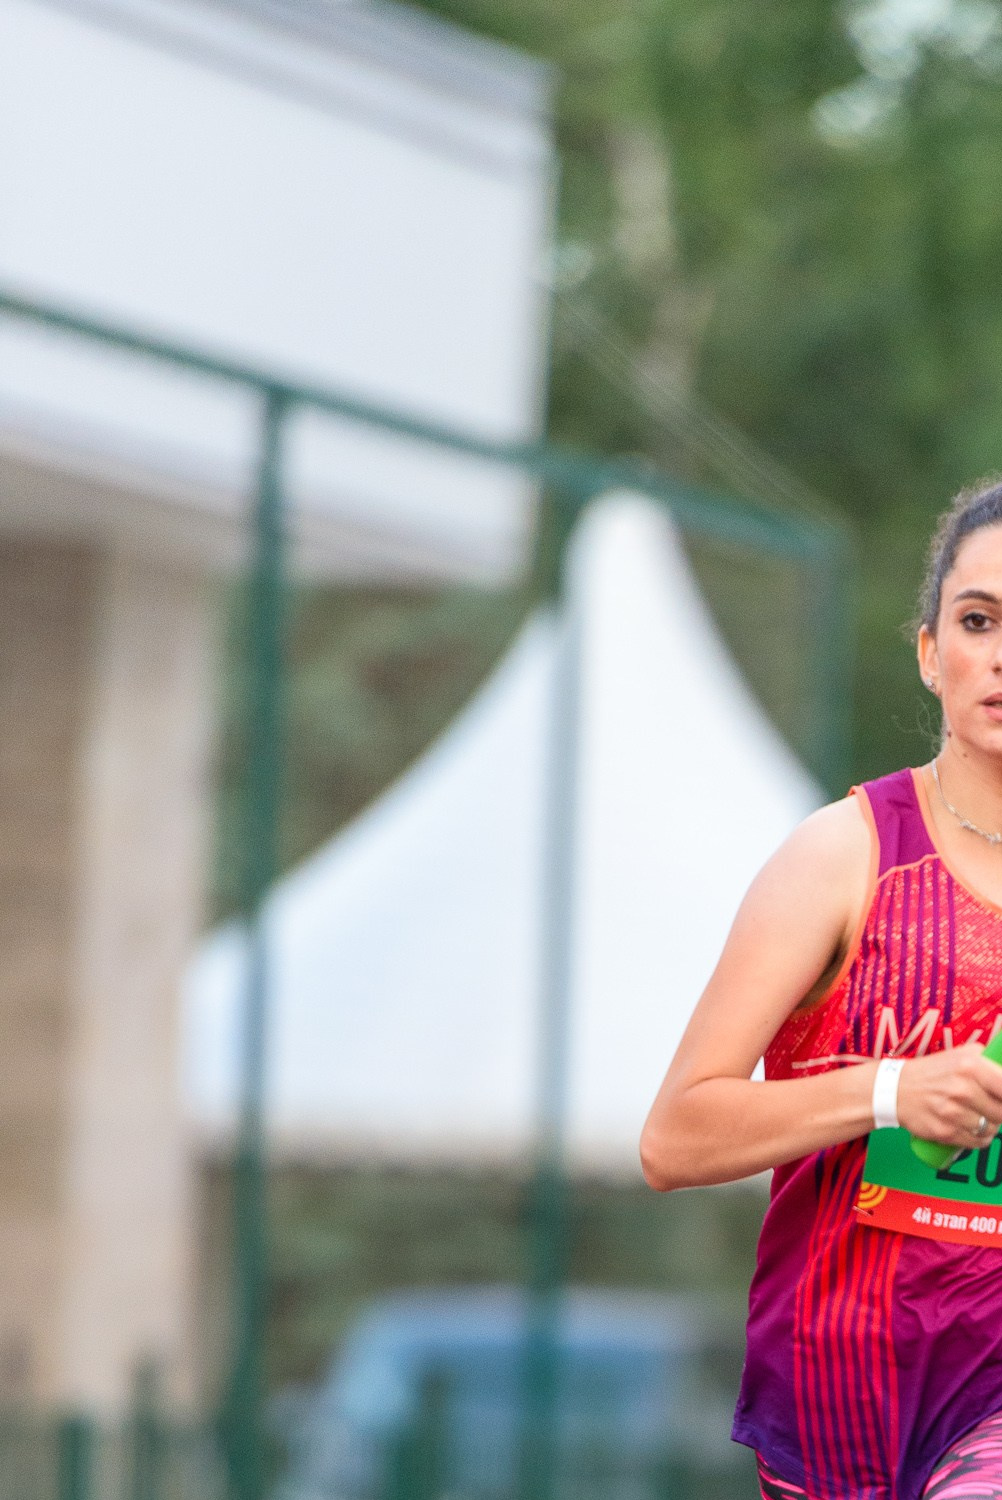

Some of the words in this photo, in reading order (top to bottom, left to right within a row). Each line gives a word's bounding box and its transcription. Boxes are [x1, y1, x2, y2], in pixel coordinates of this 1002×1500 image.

[912, 1206, 932, 1225] 4й
[933, 1212, 968, 1231] этап
[969, 1215, 997, 1234] 400
